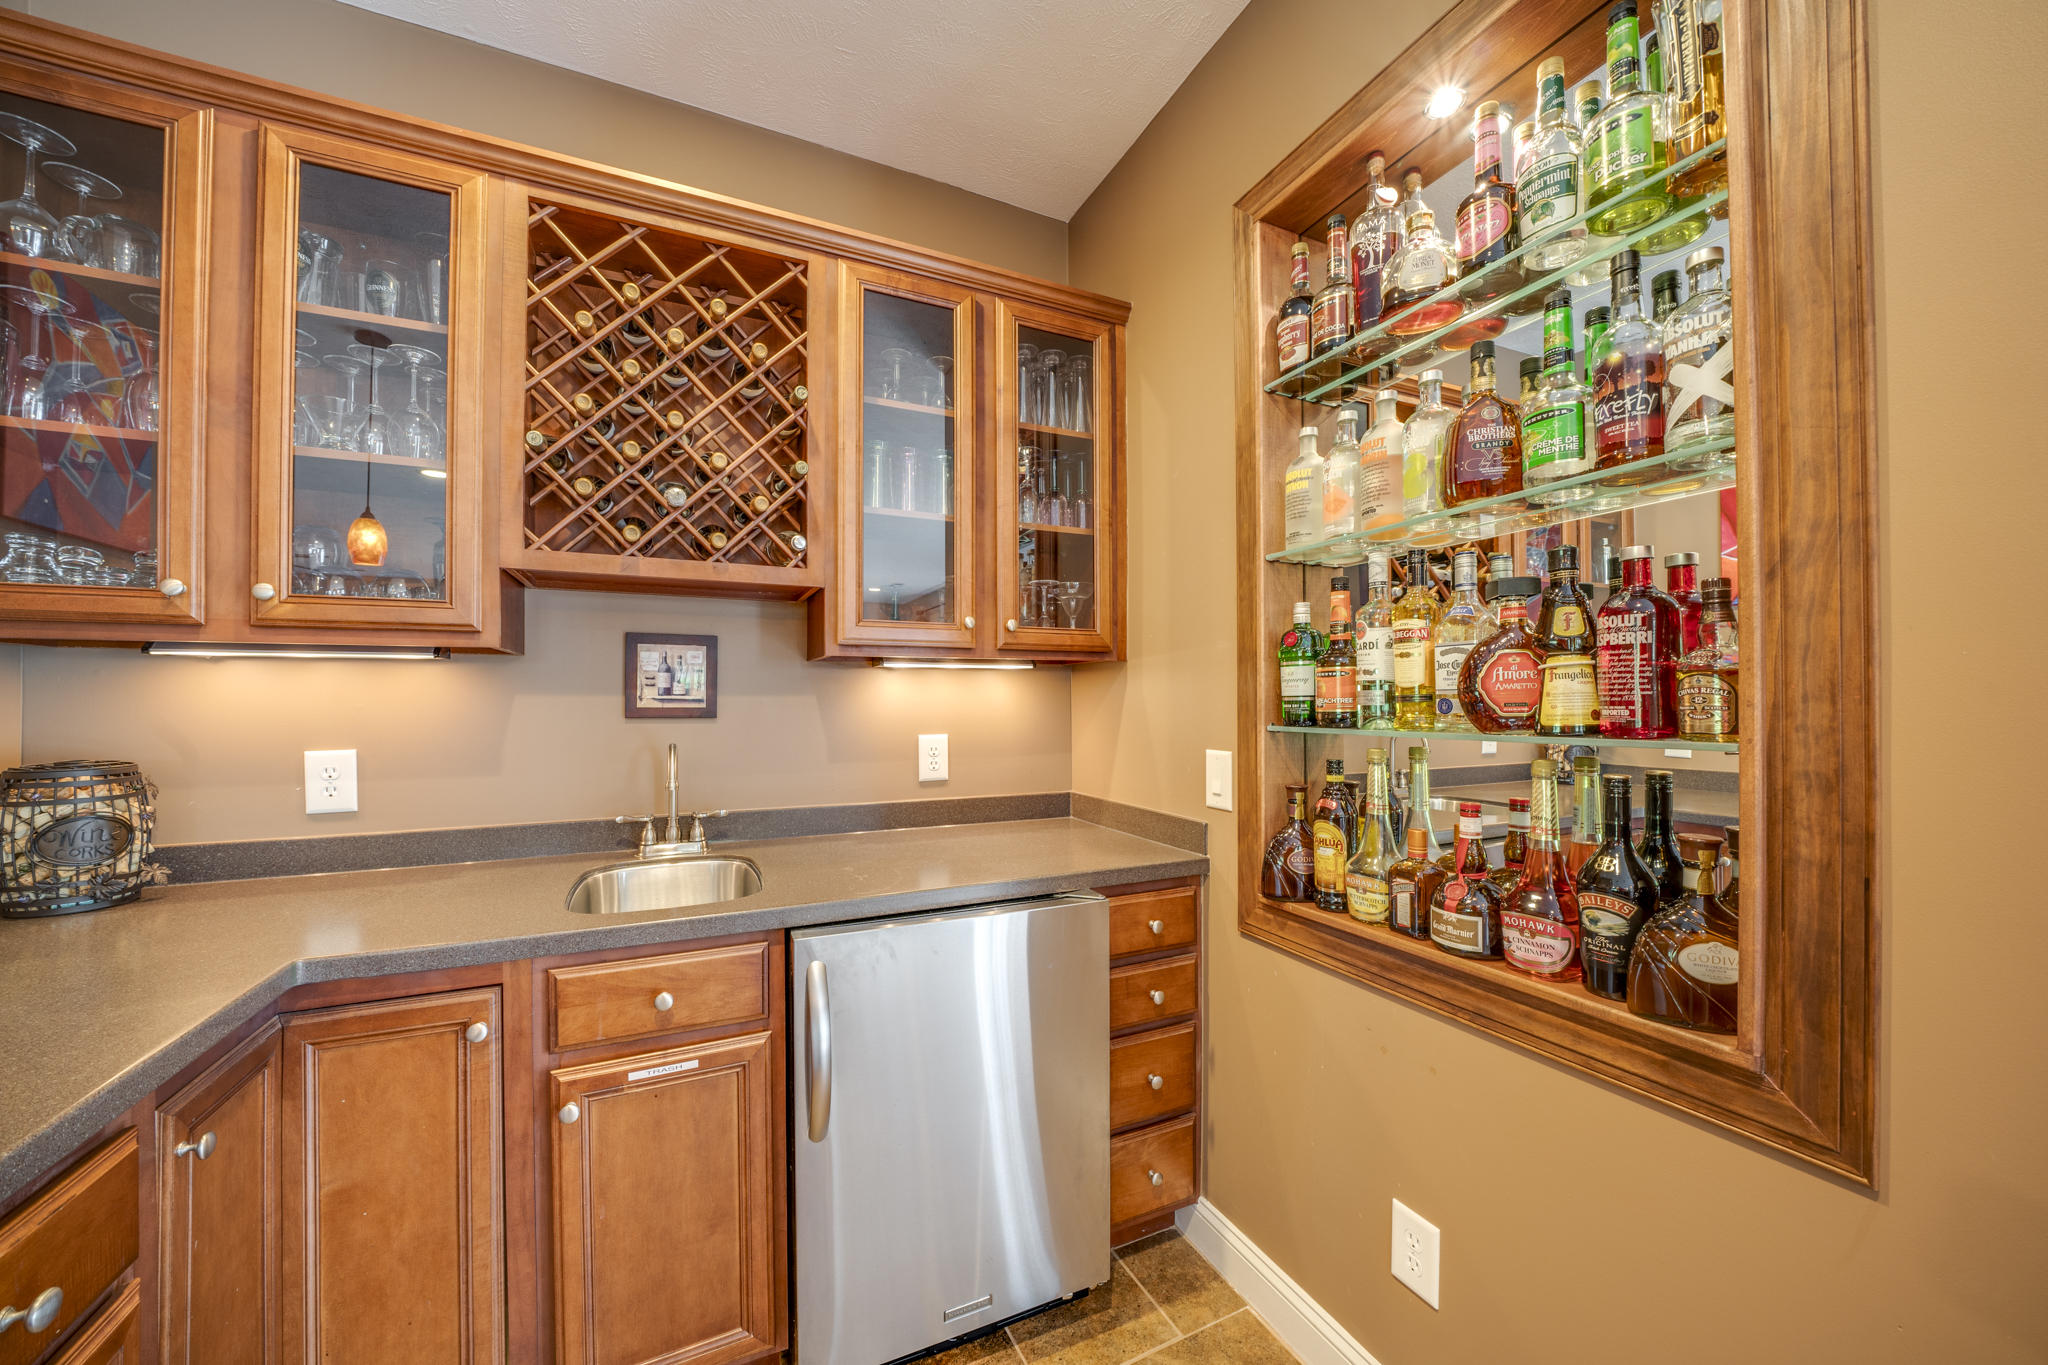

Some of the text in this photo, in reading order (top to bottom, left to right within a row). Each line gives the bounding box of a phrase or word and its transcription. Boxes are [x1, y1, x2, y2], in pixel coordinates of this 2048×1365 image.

[1594, 152, 1647, 182] pucker
[1519, 167, 1571, 203] Peppermint
[1524, 185, 1560, 208] Schnapps
[1466, 425, 1516, 436] CHRISTIAN
[1468, 432, 1516, 442] BROTHERS
[1475, 440, 1510, 449] BRANDY
[1565, 435, 1580, 443] DE
[1538, 443, 1580, 456] MENTHE
[1436, 660, 1450, 671] Jose
[1491, 666, 1538, 683] Amore
[1495, 682, 1538, 690] AMARETTO
[1678, 687, 1730, 697] CHIVAS REGAL
[1579, 894, 1633, 915] BAILEYS
[1504, 915, 1555, 934] MOHAWK
[1512, 936, 1556, 951] CINNAMON
[1583, 937, 1626, 951] ORIGINAL
[1515, 944, 1554, 959] SCHNAPPS
[1687, 952, 1738, 966] GODIV
[647, 1064, 683, 1076] TRASH
